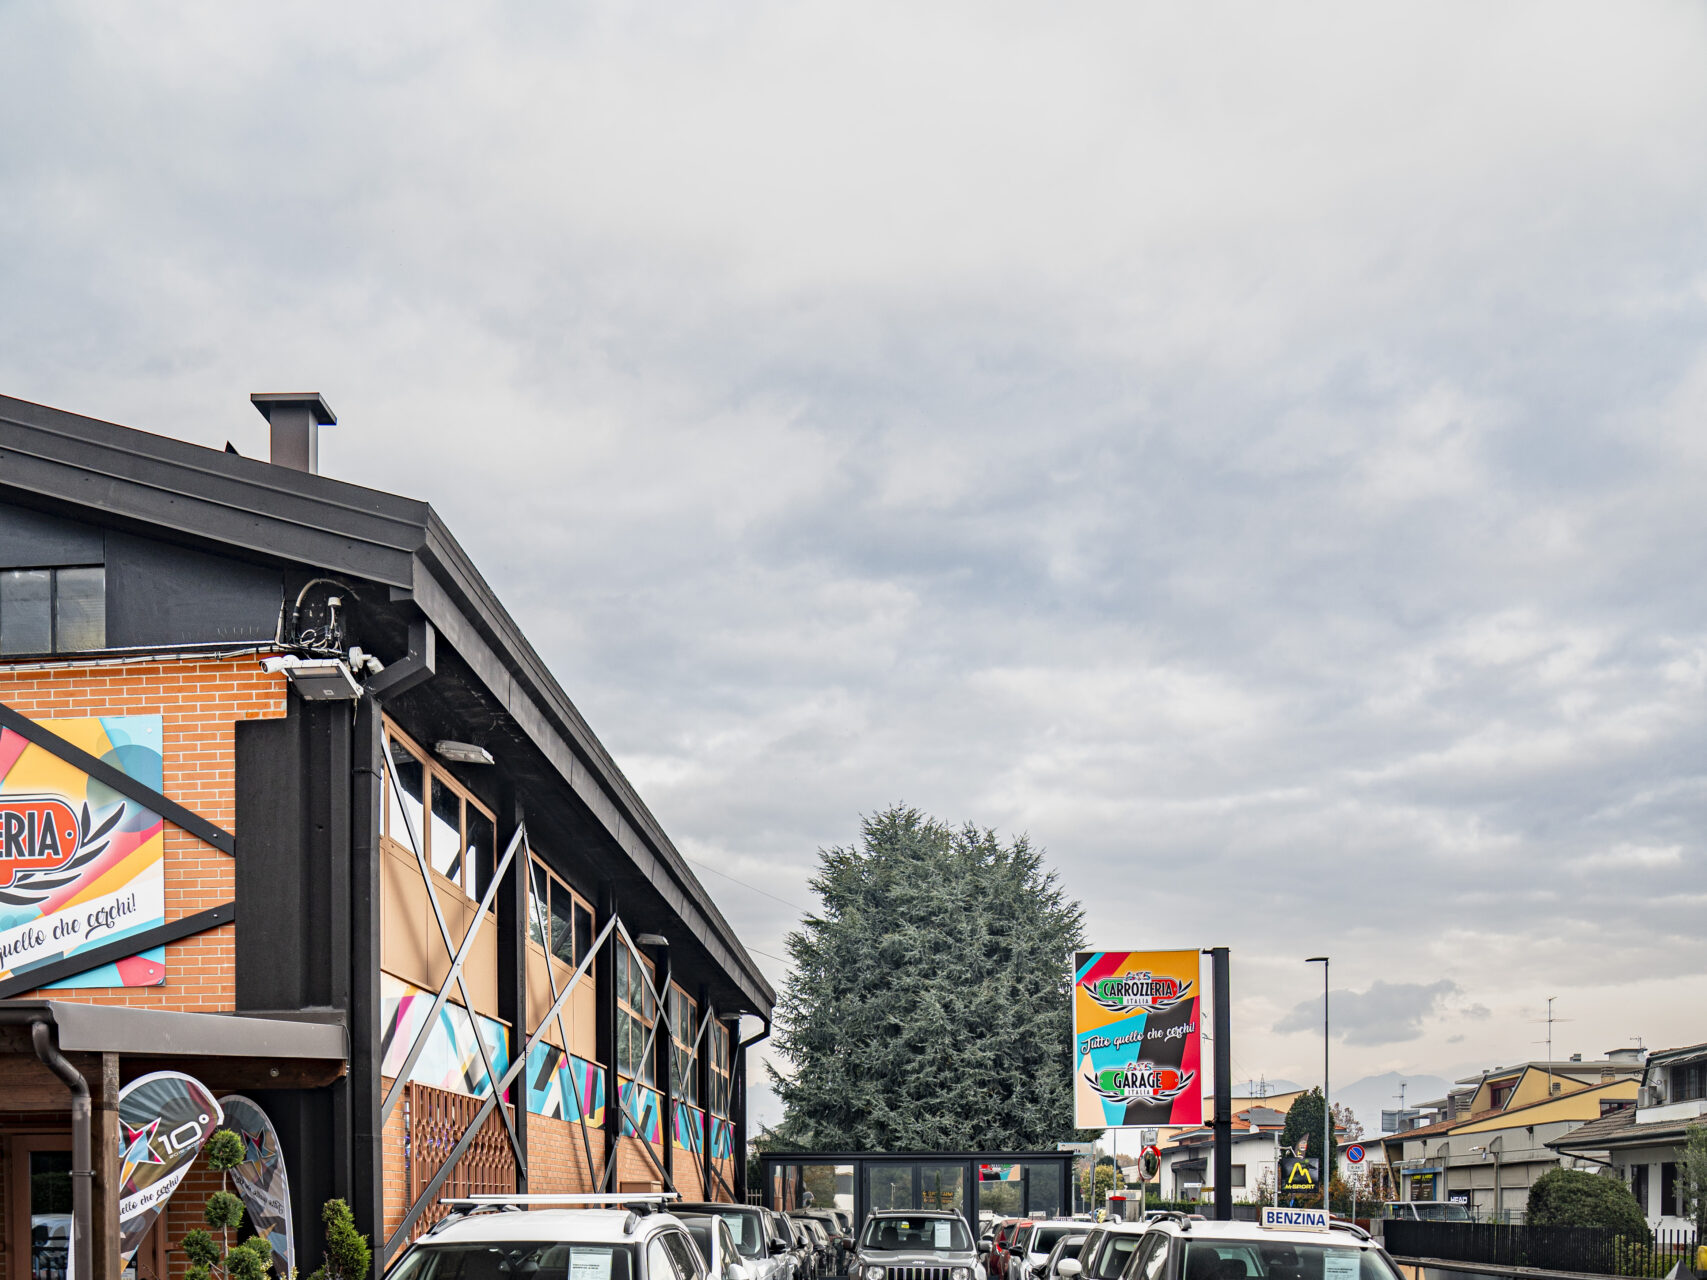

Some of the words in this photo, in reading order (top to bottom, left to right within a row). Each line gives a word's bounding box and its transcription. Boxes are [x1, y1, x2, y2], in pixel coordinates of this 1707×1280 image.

[0, 810, 62, 858] RIA
[53, 918, 80, 940] che
[85, 893, 136, 940] cerchi!
[1103, 982, 1173, 997] CARROZZERIA
[1081, 1035, 1111, 1054] Tutto
[1113, 1030, 1144, 1050] quello
[1147, 1028, 1164, 1040] che
[1164, 1021, 1195, 1042] cerchi!
[1113, 1072, 1162, 1088] GARAGE
[157, 1113, 210, 1155] 10°
[140, 1193, 154, 1206] che
[155, 1176, 179, 1202] cerchi!
[1450, 1196, 1468, 1204] HEAD
[1267, 1211, 1326, 1226] BENZINA
